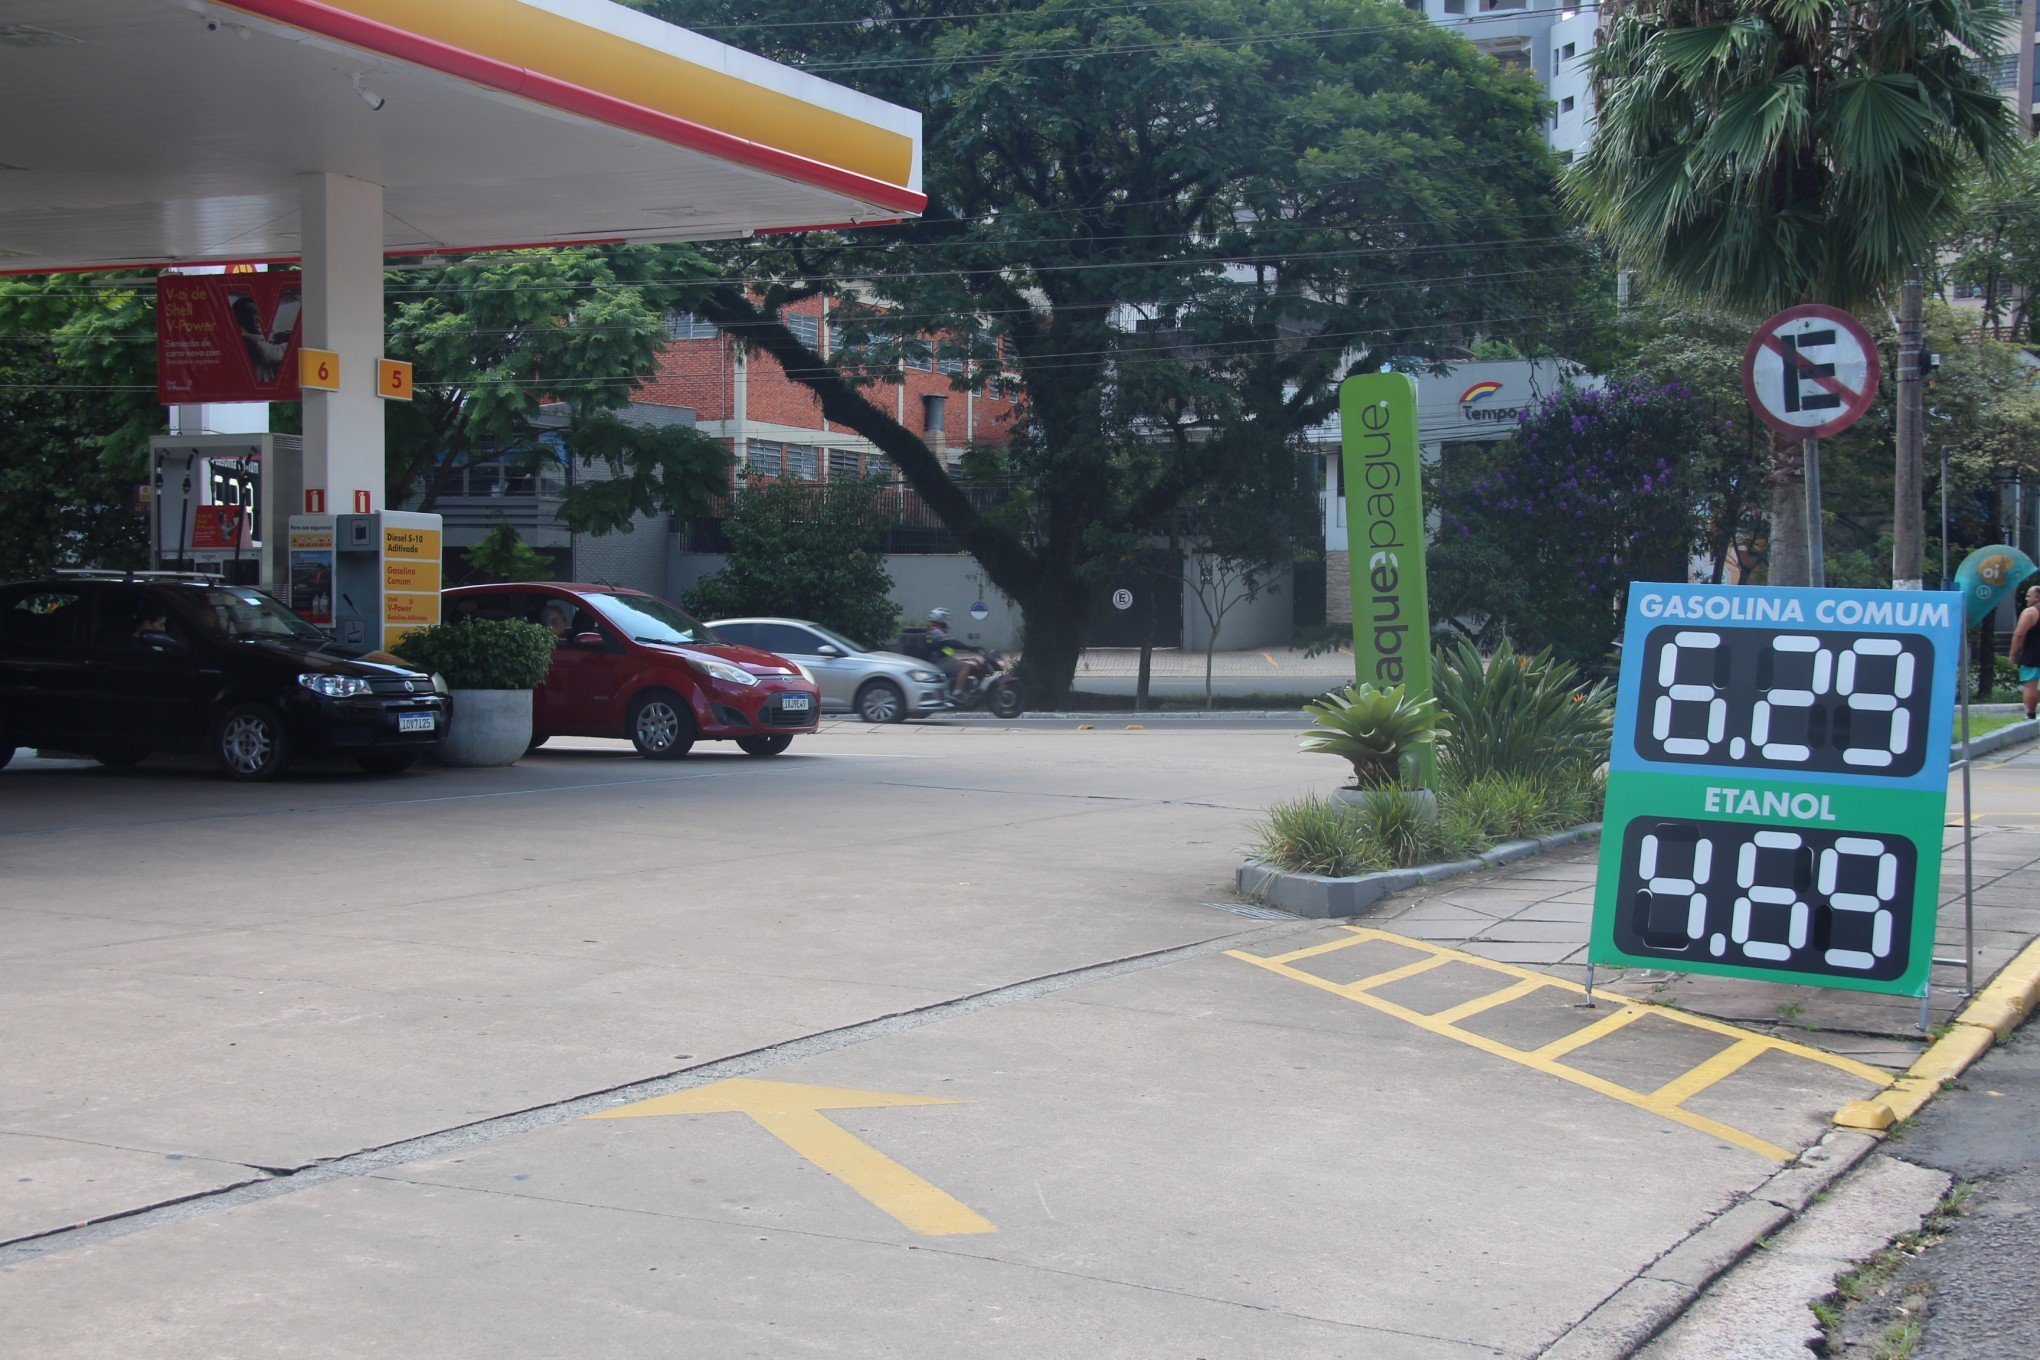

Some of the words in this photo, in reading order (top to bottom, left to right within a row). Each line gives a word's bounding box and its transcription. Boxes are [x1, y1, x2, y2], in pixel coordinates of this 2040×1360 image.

[191, 286, 207, 300] de
[166, 301, 193, 316] Shell
[167, 319, 217, 332] V-Power
[166, 339, 199, 349] Sensação
[201, 339, 211, 348] de
[166, 350, 184, 358] carro
[186, 349, 205, 357] novo
[318, 361, 329, 381] 6
[1781, 329, 1840, 413] E
[392, 370, 402, 389] 5
[1462, 405, 1518, 423] Tempo
[387, 533, 407, 542] Diesel
[408, 535, 423, 543] S-10
[387, 544, 419, 553] Aditivado
[387, 566, 416, 576] Gasolina
[1982, 564, 1999, 579] oi
[387, 577, 411, 586] Comum
[387, 603, 412, 612] V-Power
[1639, 593, 1804, 623] GASOLINA
[1815, 599, 1950, 628] COMUM
[1652, 631, 1915, 767] 6.29
[1704, 787, 1836, 821] ETANOL
[1638, 830, 1897, 970] 4.69
